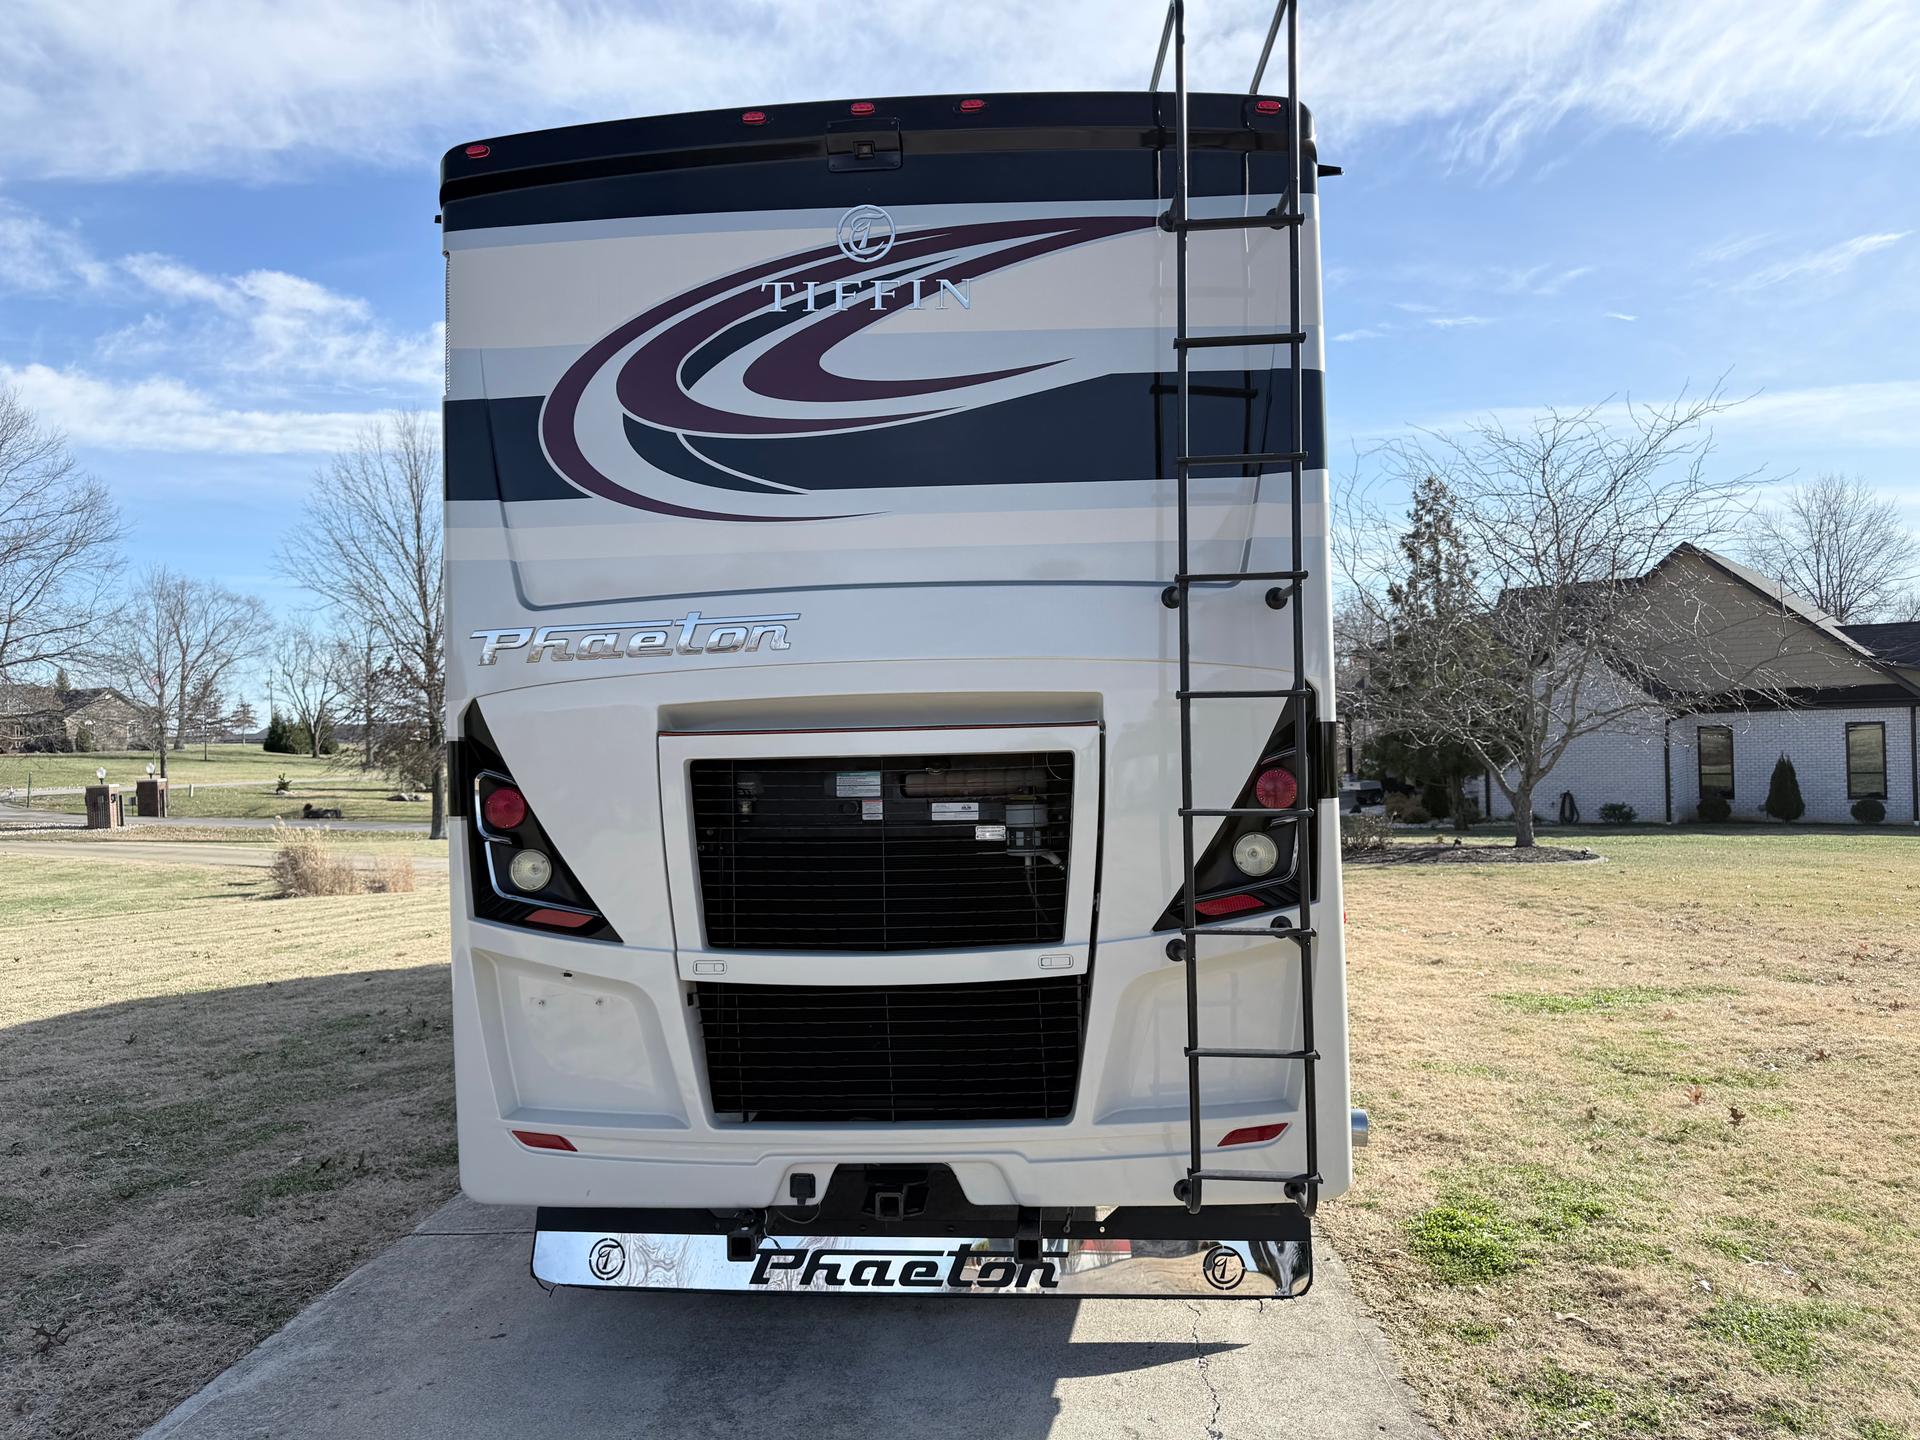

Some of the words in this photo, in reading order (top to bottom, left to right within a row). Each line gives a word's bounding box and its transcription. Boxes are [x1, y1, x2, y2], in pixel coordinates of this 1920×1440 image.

[761, 278, 974, 313] TIFFIN
[469, 610, 801, 667] Phaeton
[749, 1243, 1069, 1288] Phaeton
